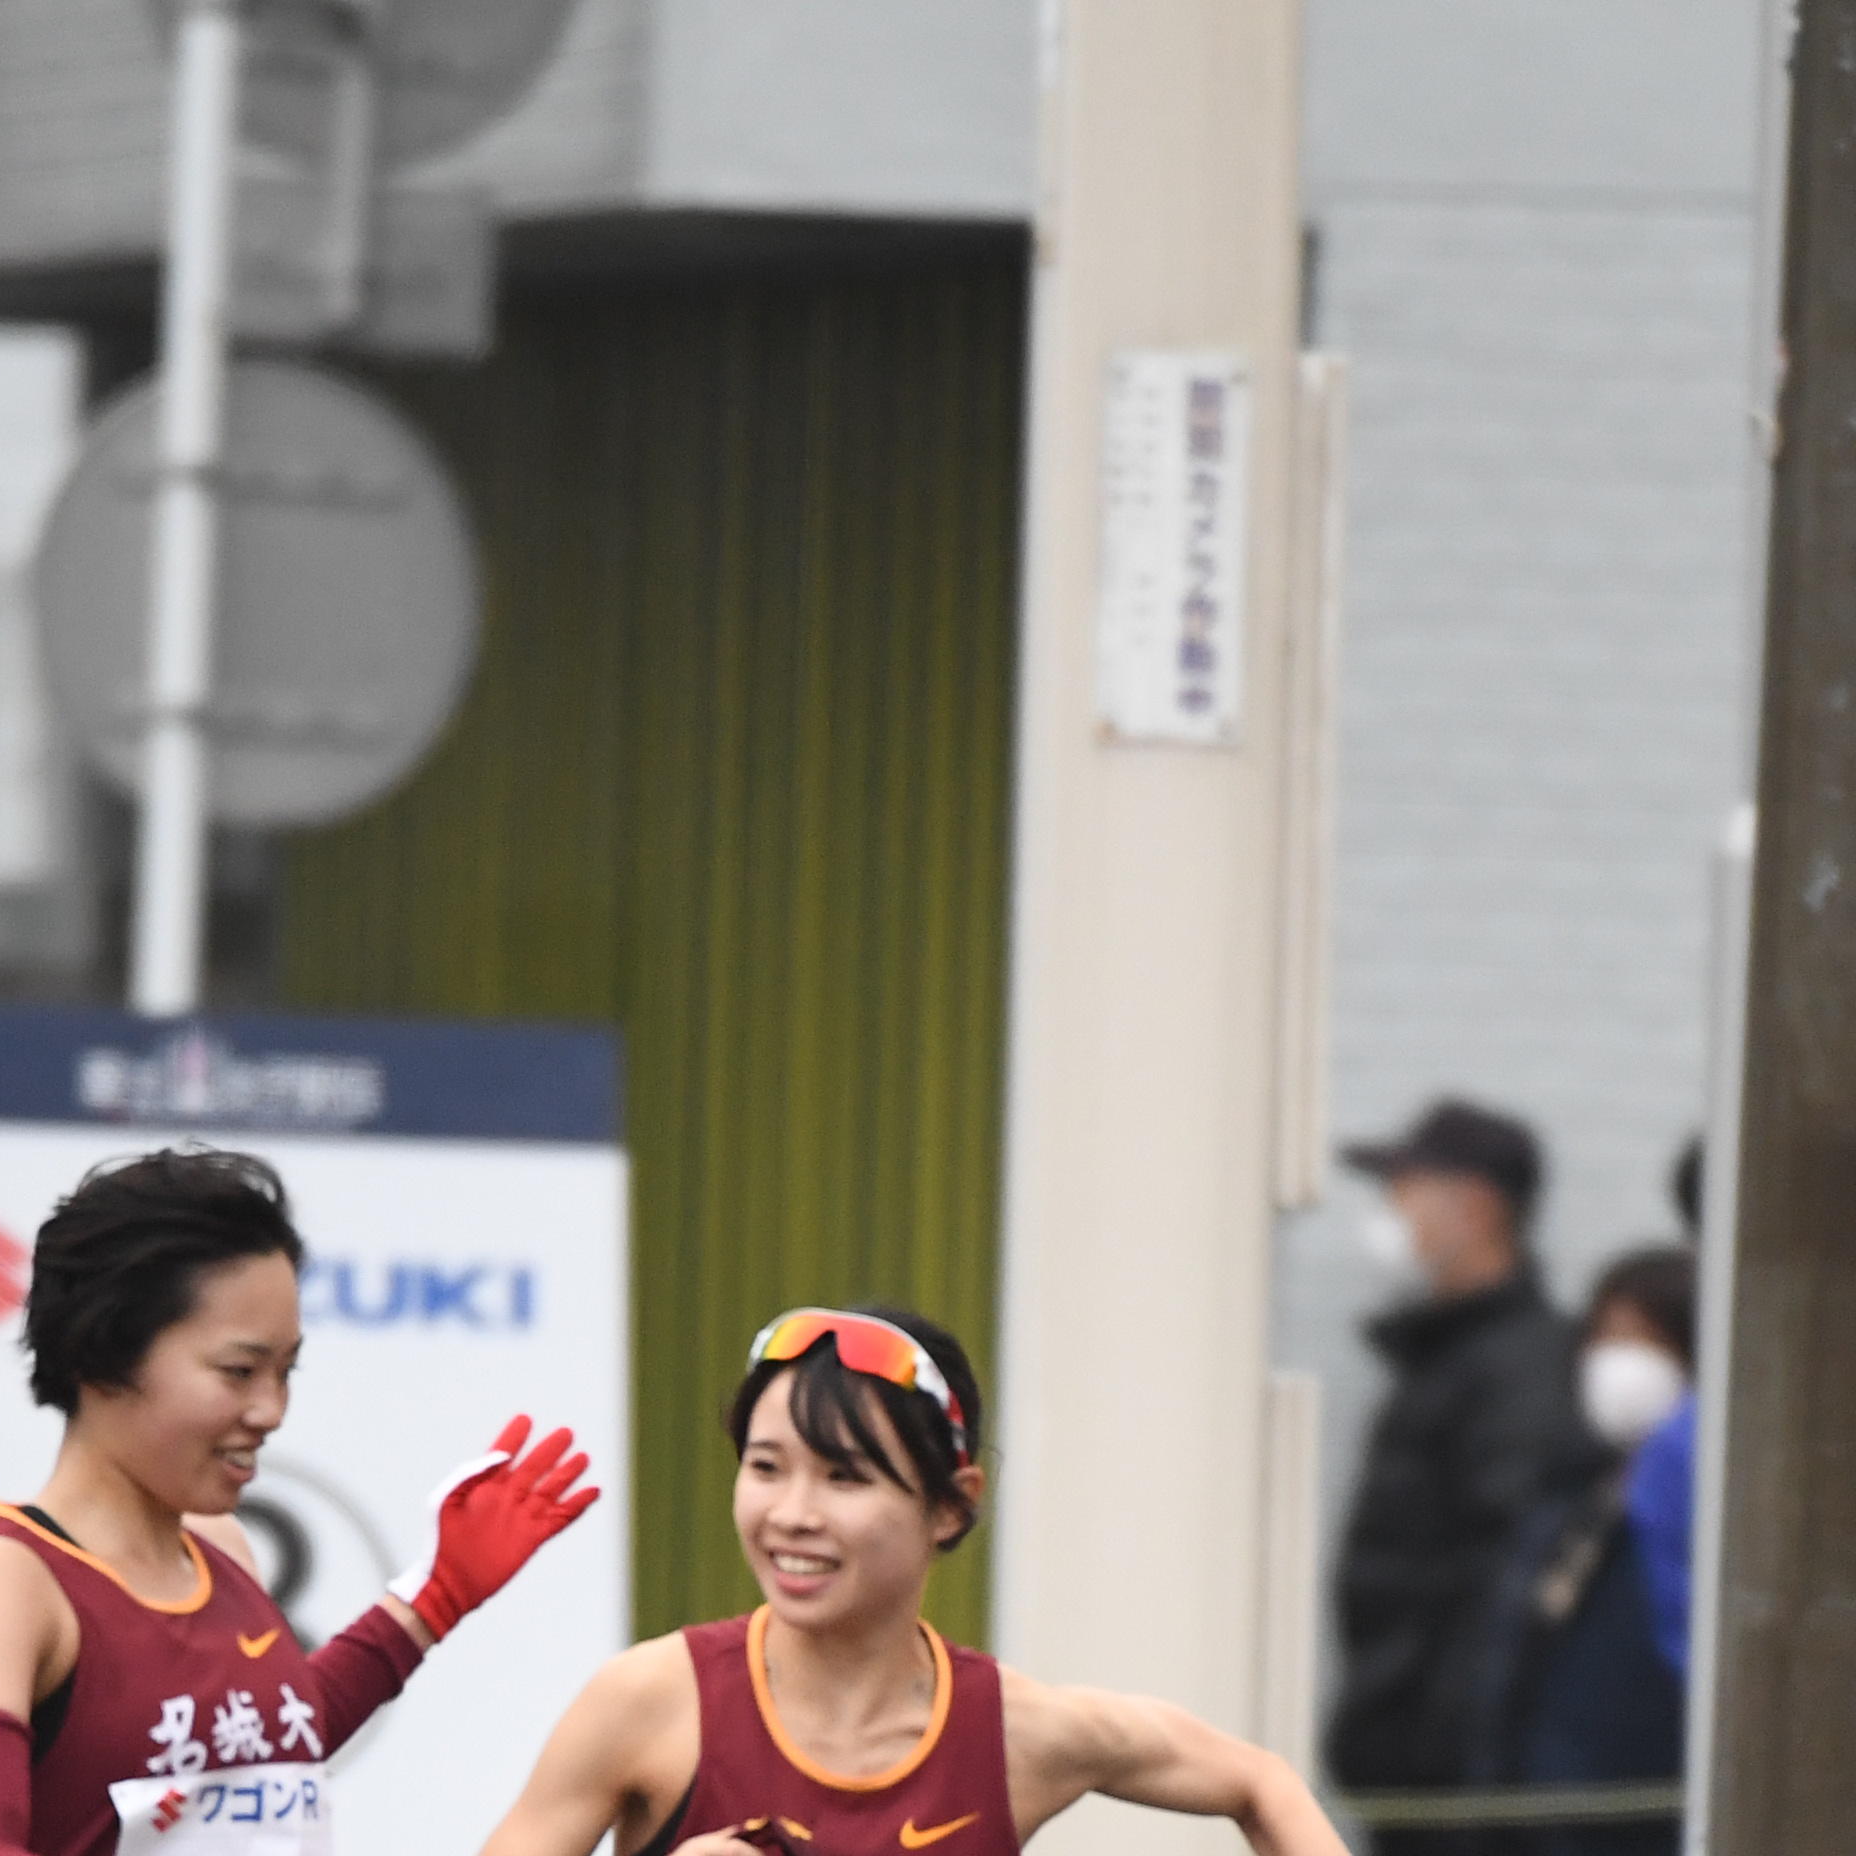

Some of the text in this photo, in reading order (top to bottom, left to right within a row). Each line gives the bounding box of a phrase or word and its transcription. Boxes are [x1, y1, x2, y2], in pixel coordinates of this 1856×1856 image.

[300, 1257, 533, 1327] ZUKI
[198, 1779, 319, 1822] ワゴンR
